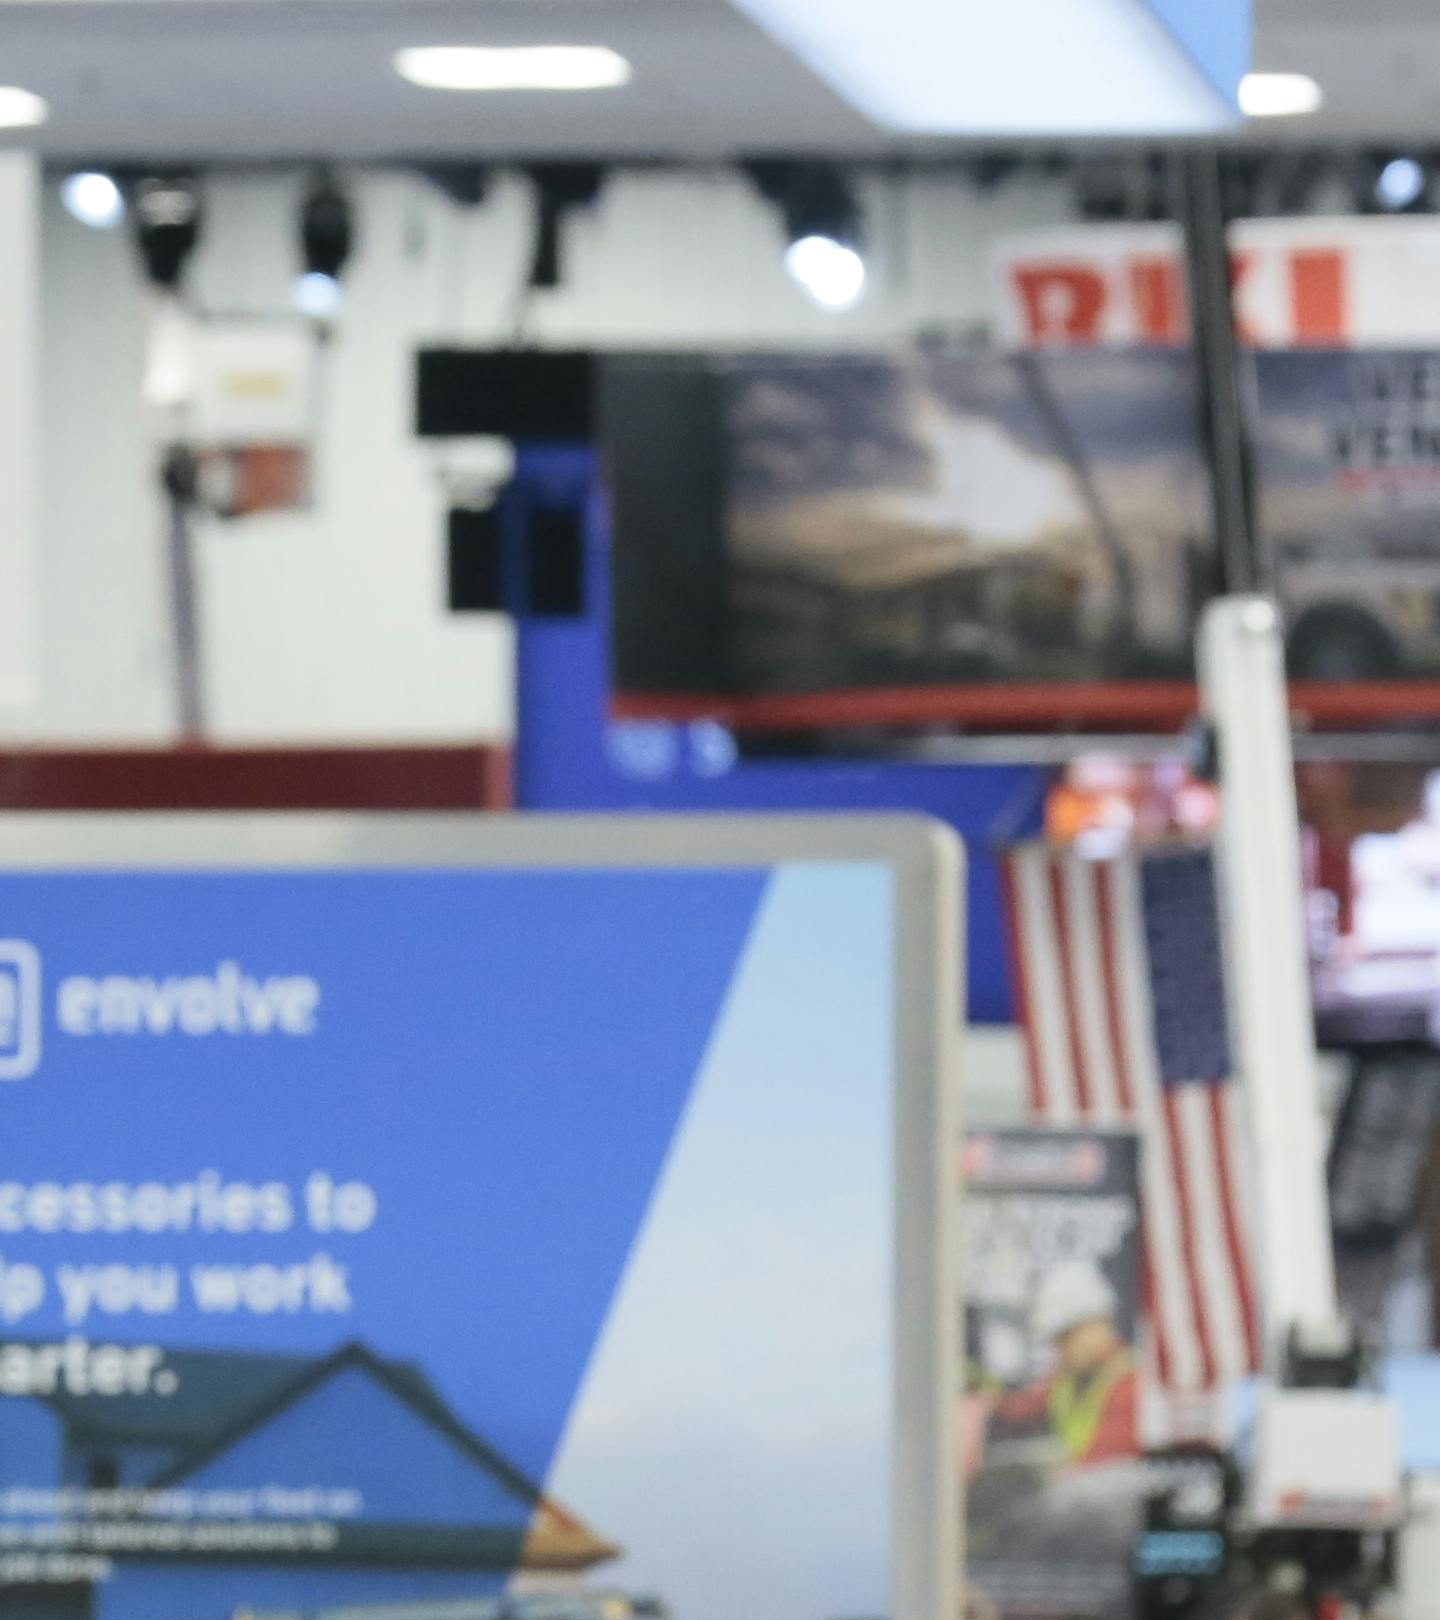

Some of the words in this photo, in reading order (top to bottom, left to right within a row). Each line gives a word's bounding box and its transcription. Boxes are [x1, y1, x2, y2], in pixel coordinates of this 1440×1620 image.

[56, 960, 321, 1035] envolve
[305, 1169, 378, 1234] to
[57, 1263, 179, 1325] you
[191, 1251, 352, 1315] work
